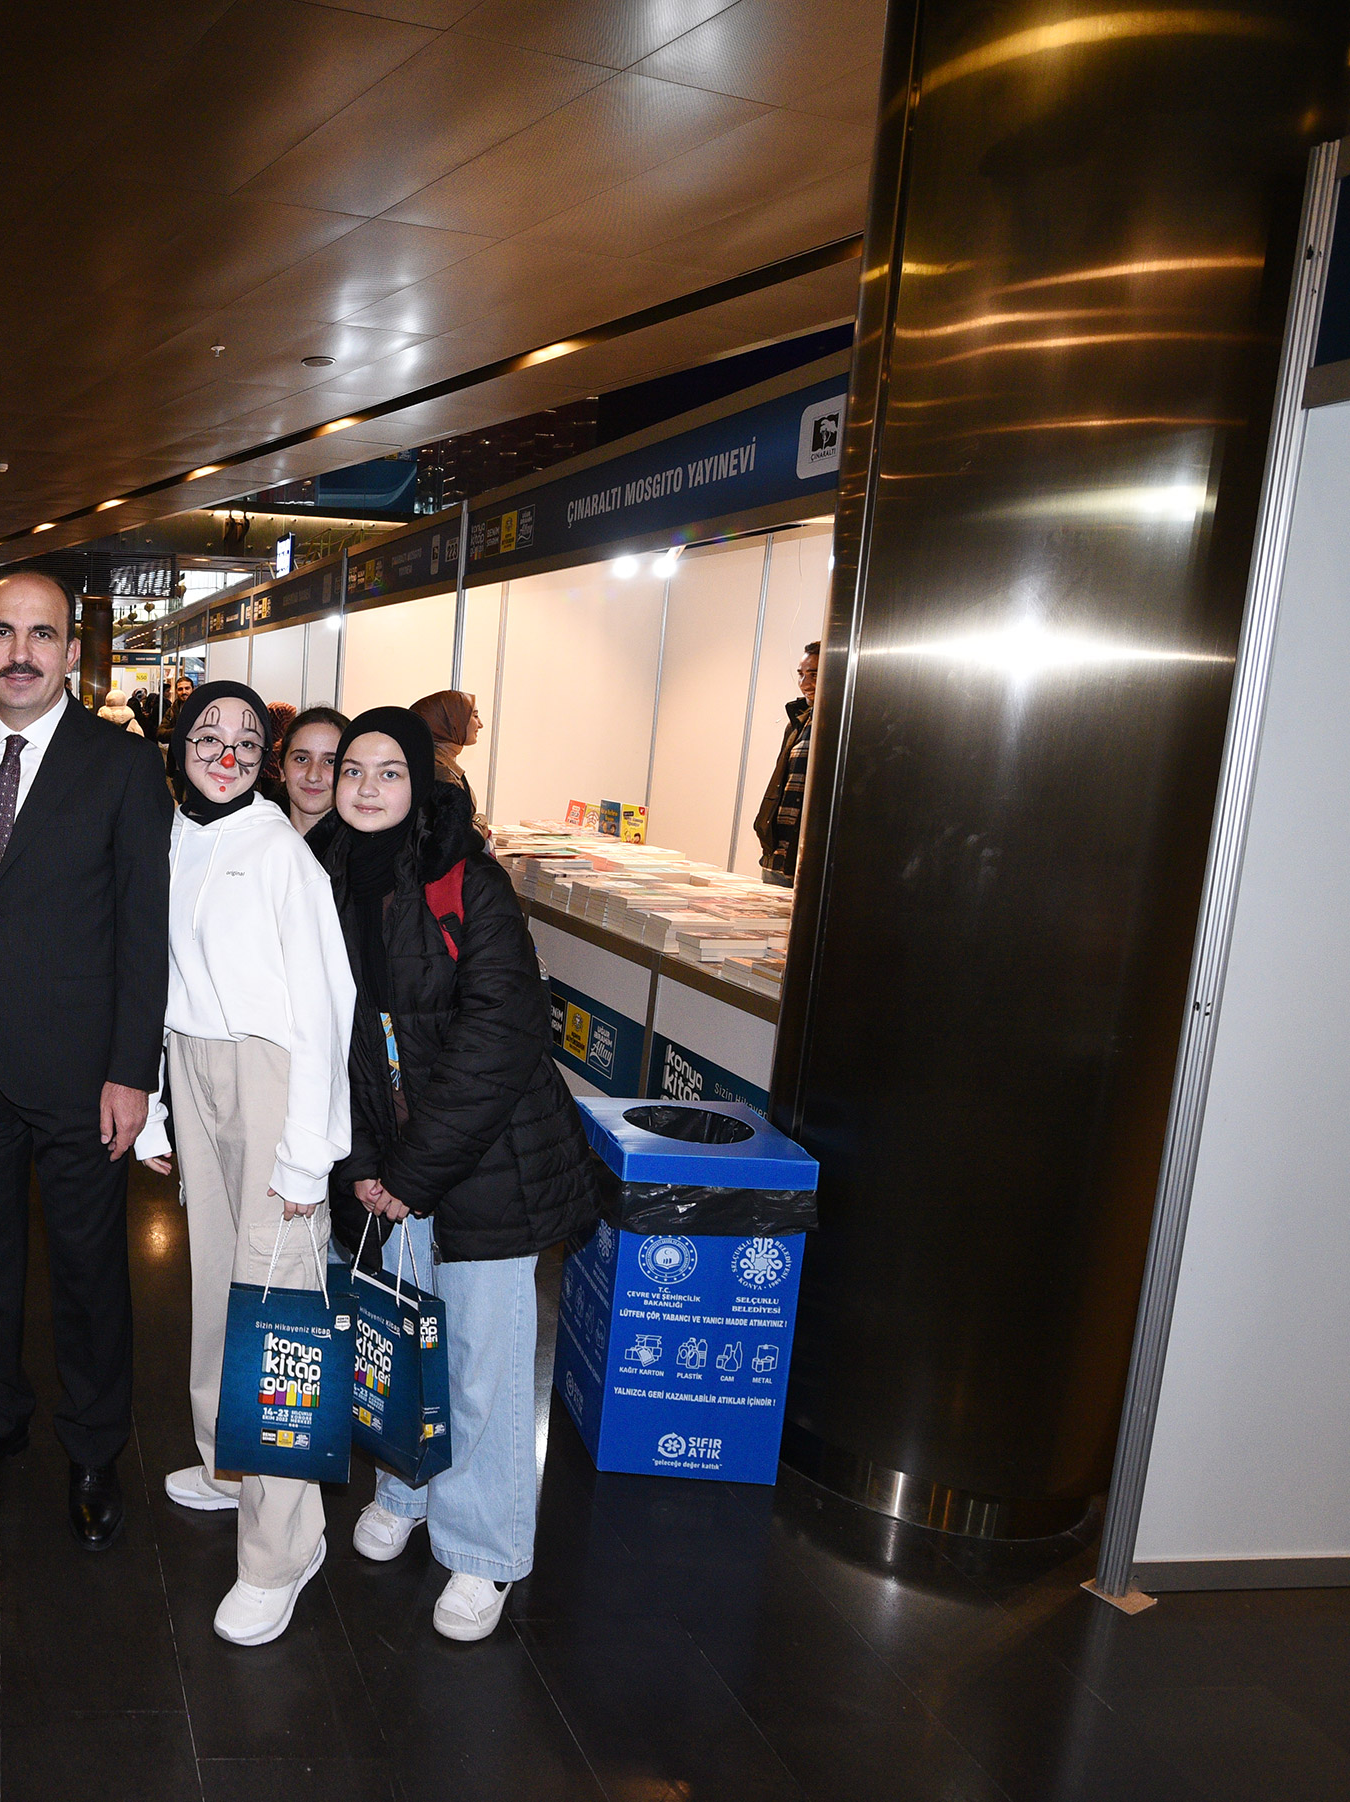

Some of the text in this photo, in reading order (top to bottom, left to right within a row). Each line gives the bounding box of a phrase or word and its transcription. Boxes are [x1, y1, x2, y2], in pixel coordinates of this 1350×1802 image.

[567, 436, 757, 529] ÇINARALTI MOSGITO YAYINEVİ
[665, 1043, 703, 1091] konya
[714, 1082, 733, 1102] Sizin
[658, 1286, 671, 1294] T.C.
[738, 1277, 763, 1291] KONYA
[627, 1290, 701, 1303] ÇEVRE VE ŞEHİRCİLİK
[735, 1296, 780, 1306] SELÇUKLU
[643, 1299, 683, 1309] BAKANLIĞI
[732, 1305, 781, 1314] BELEDİYESİ
[619, 1308, 645, 1319] LÜTFEN
[662, 1312, 691, 1323] YABANCI
[692, 1315, 701, 1323] VE
[702, 1315, 724, 1325] YANICI
[725, 1317, 748, 1326] MADDE
[749, 1318, 783, 1328] ATMAYINIZ
[255, 1321, 330, 1335] Sizin Hikayeniz Kitap
[264, 1332, 322, 1363] konya
[262, 1350, 321, 1383] kitap
[619, 1366, 664, 1377] KAĞIT KARTON
[676, 1372, 703, 1380] PLASTİK
[259, 1375, 320, 1396] günleri
[613, 1386, 646, 1397] YALNIZCA
[647, 1390, 664, 1400] GERİ
[665, 1392, 716, 1404] KAZANILABİLİR
[717, 1396, 746, 1406] ATIKLAR
[747, 1396, 772, 1408] İÇİNDİR
[263, 1407, 289, 1417] 14-23
[688, 1437, 722, 1449] SIFIR
[687, 1448, 720, 1459] ATIK
[683, 1461, 700, 1469] değer
